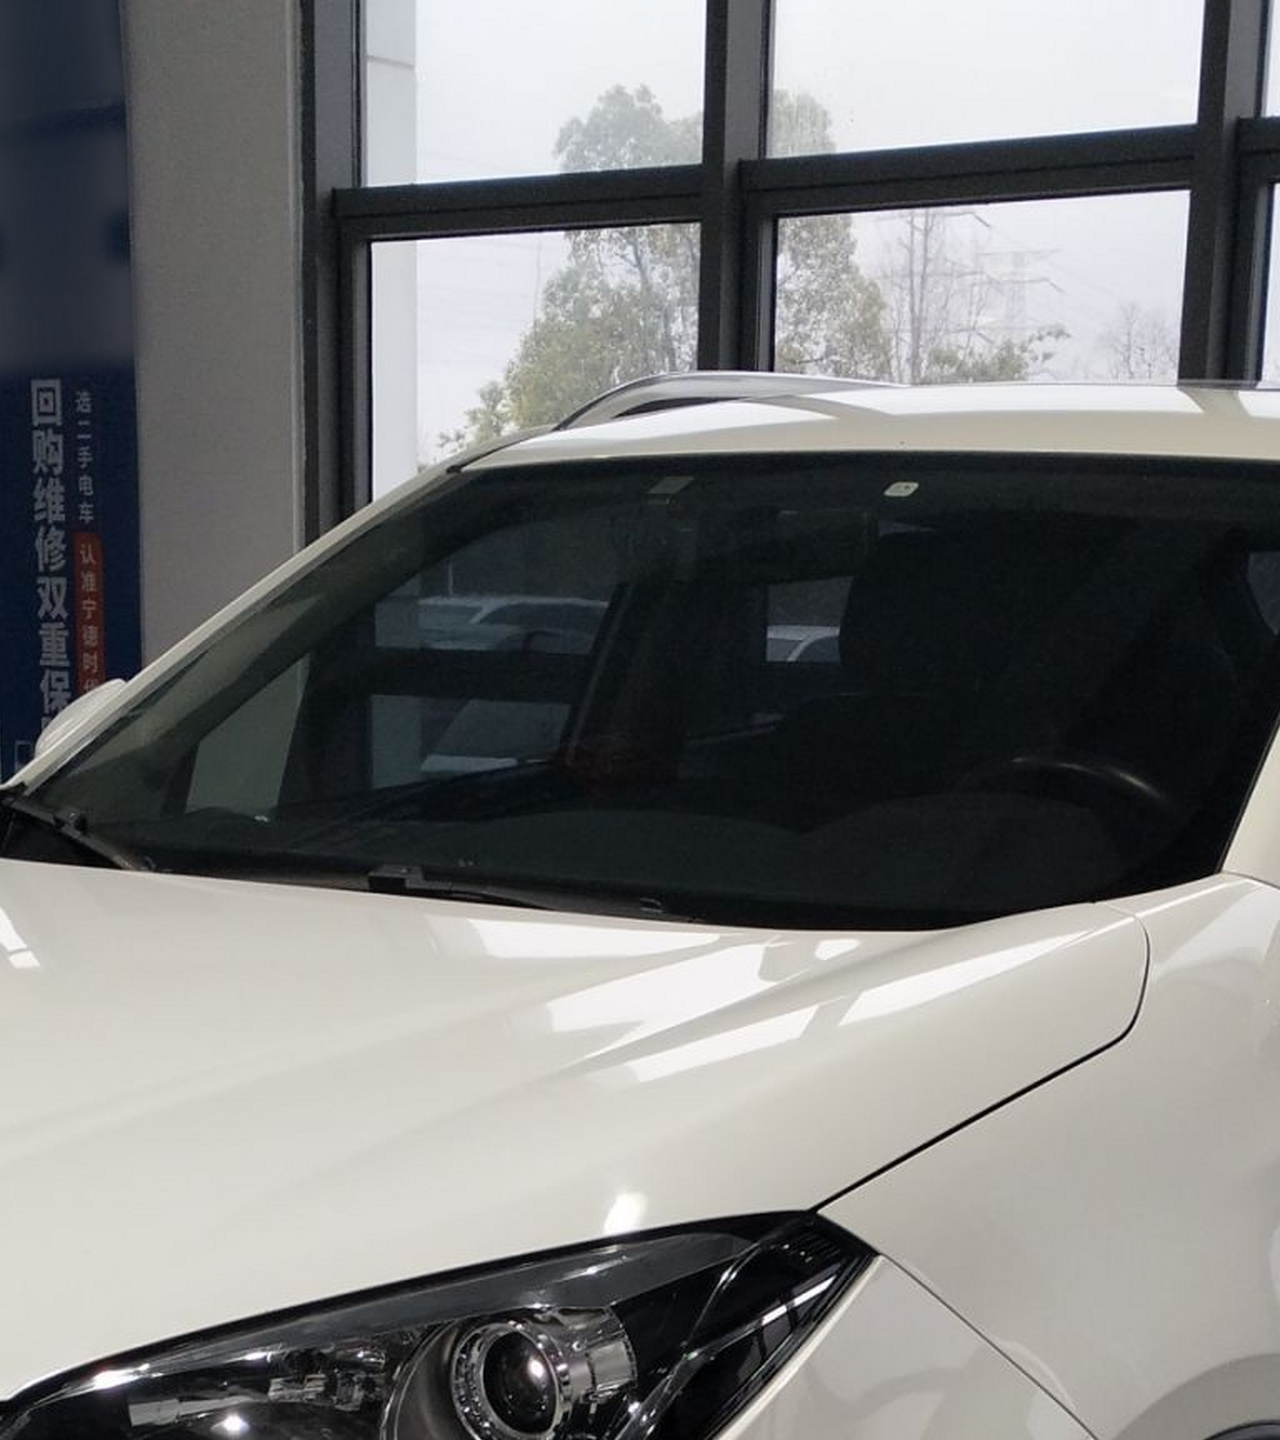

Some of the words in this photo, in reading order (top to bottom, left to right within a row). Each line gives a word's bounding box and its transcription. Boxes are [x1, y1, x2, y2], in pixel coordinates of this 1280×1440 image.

[29, 377, 72, 732] 回购维修双重保
[74, 389, 96, 525] 选二手电车
